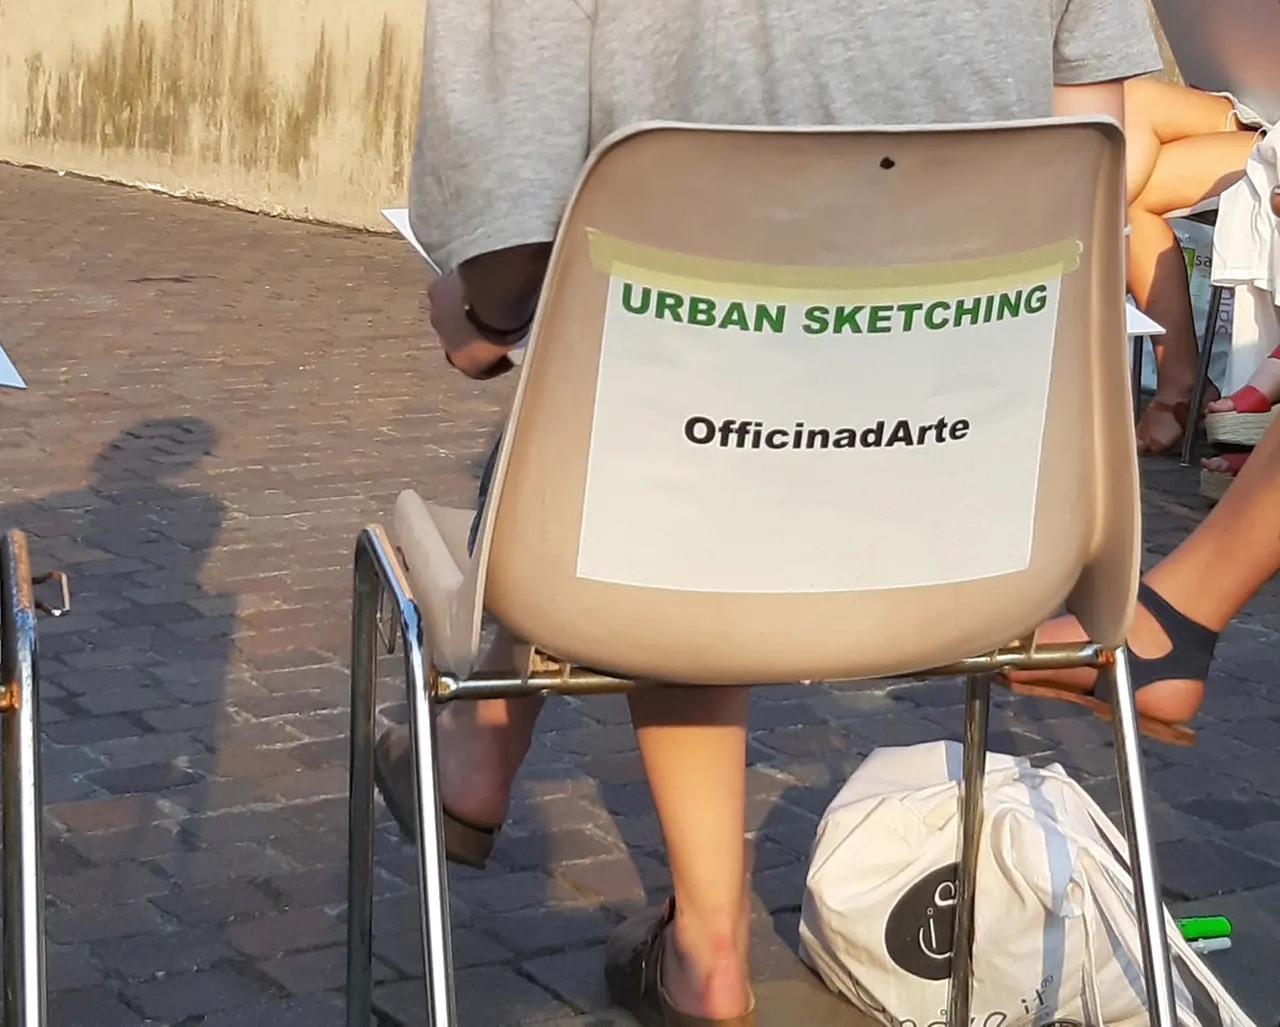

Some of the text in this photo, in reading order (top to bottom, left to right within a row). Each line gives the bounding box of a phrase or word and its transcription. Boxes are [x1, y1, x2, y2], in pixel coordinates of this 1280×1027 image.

[621, 281, 1048, 335] URBAN SKETCHING
[683, 415, 971, 450] OfficinadArte
